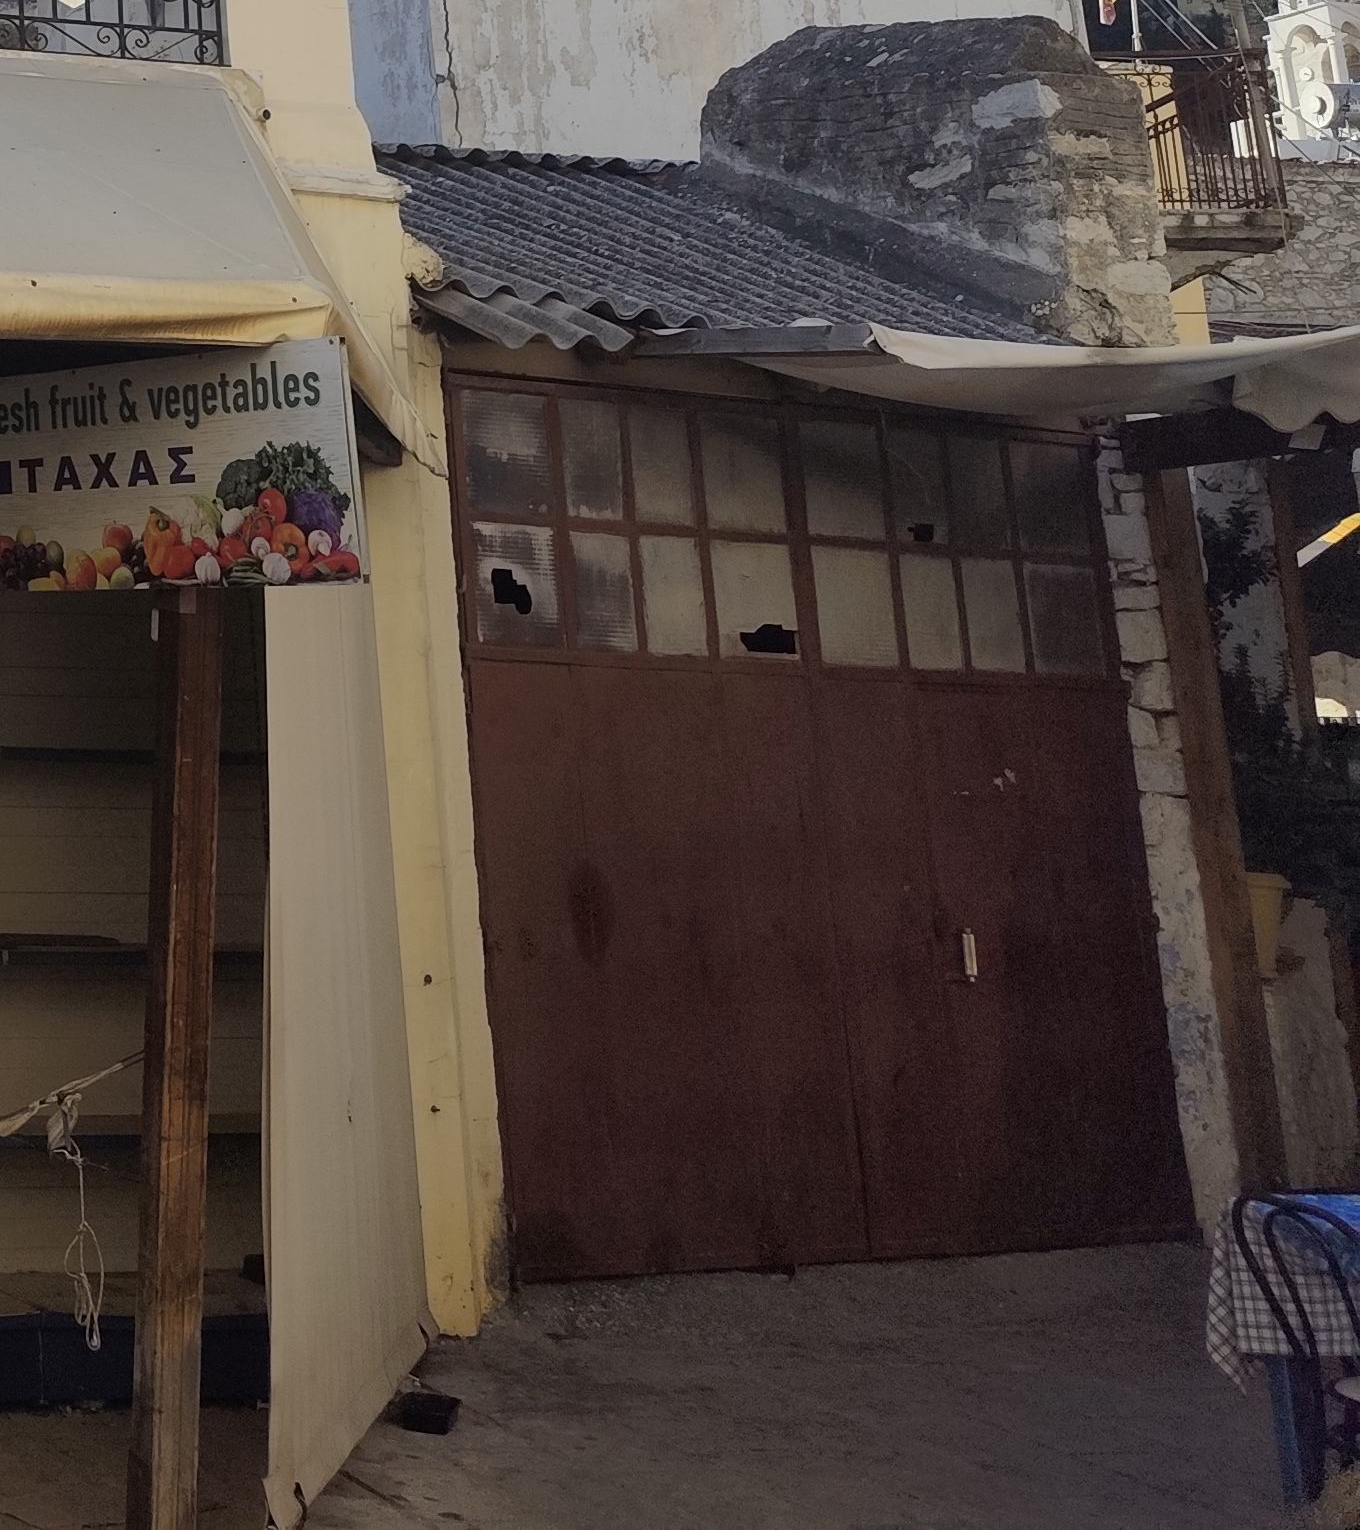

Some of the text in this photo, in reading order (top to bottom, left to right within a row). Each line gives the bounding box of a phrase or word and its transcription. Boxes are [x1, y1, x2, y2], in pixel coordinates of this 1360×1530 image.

[49, 382, 108, 429] fruit
[118, 378, 138, 423] &
[147, 361, 320, 429] vegetables
[18, 446, 196, 493] ΤΑΧΑΣ
